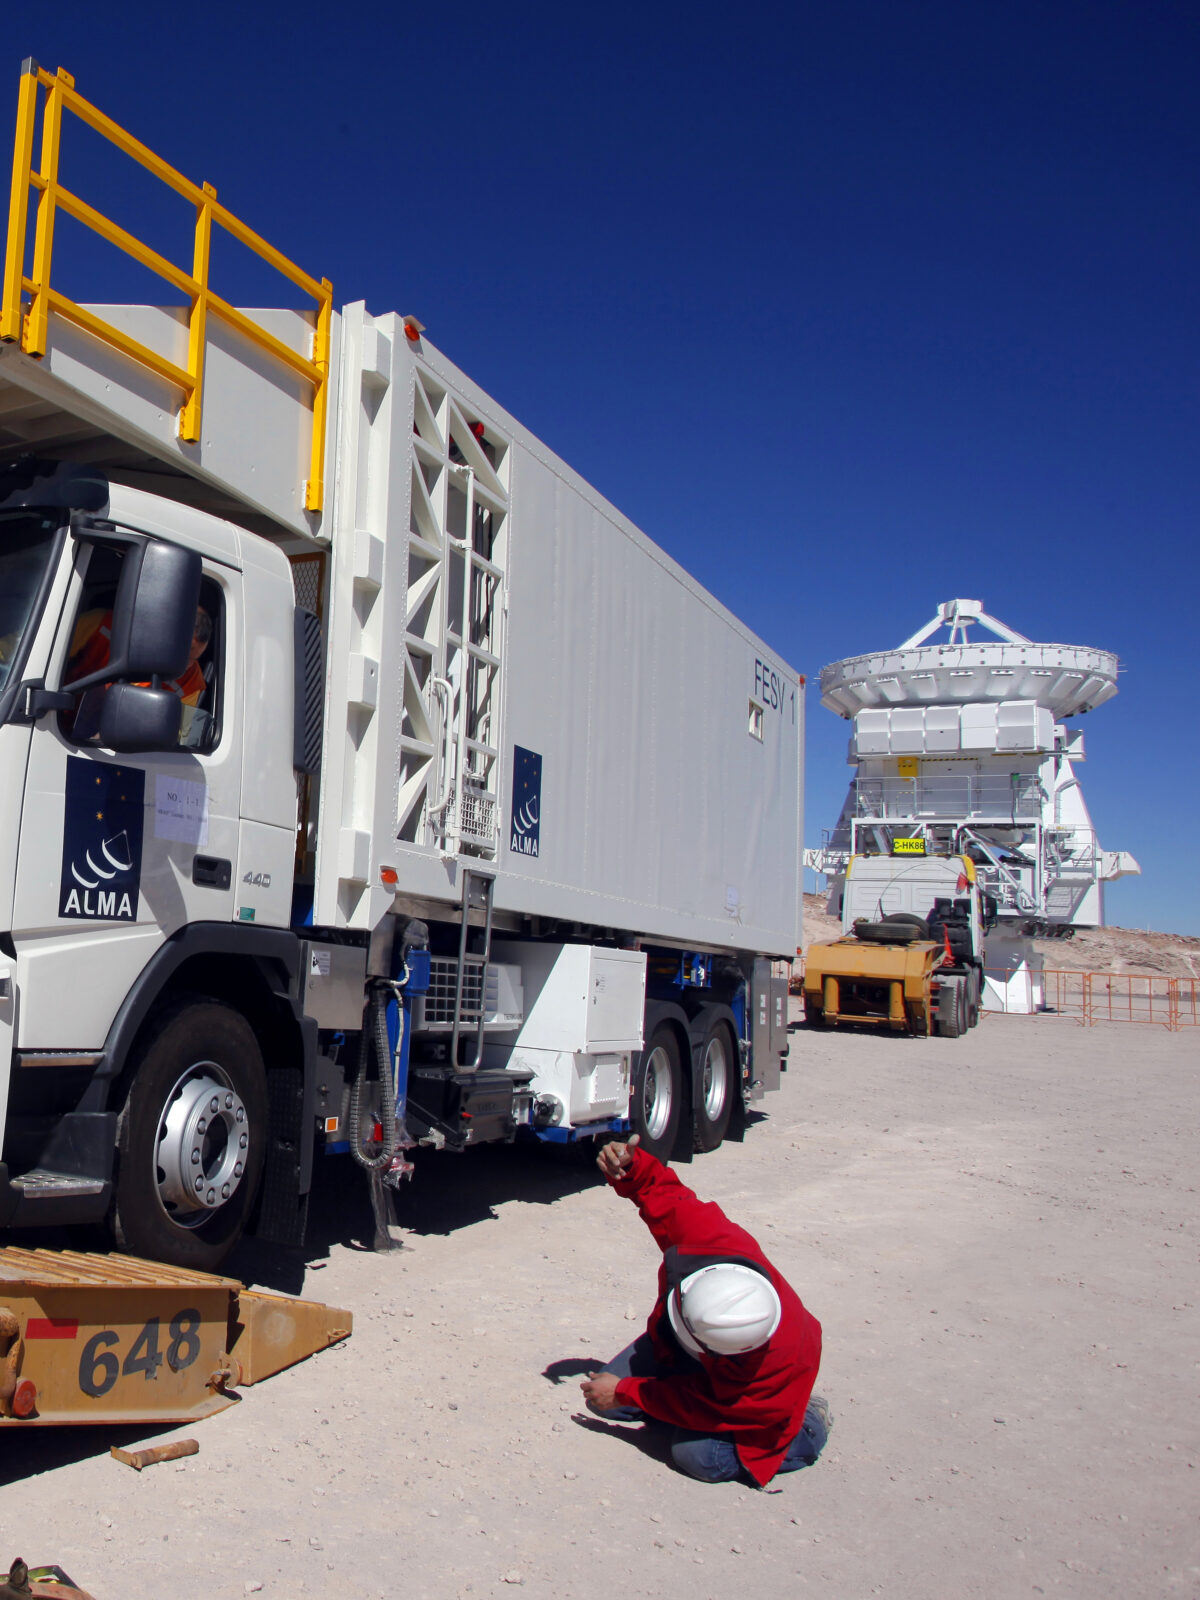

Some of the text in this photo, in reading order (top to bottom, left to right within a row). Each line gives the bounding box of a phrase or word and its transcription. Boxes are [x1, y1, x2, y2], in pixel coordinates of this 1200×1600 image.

[754, 658, 795, 725] FESV 1
[510, 833, 538, 856] ALMA
[893, 841, 925, 850] C-HK86
[242, 871, 271, 888] 440
[64, 888, 133, 917] ALMA
[78, 1308, 202, 1398] 648
